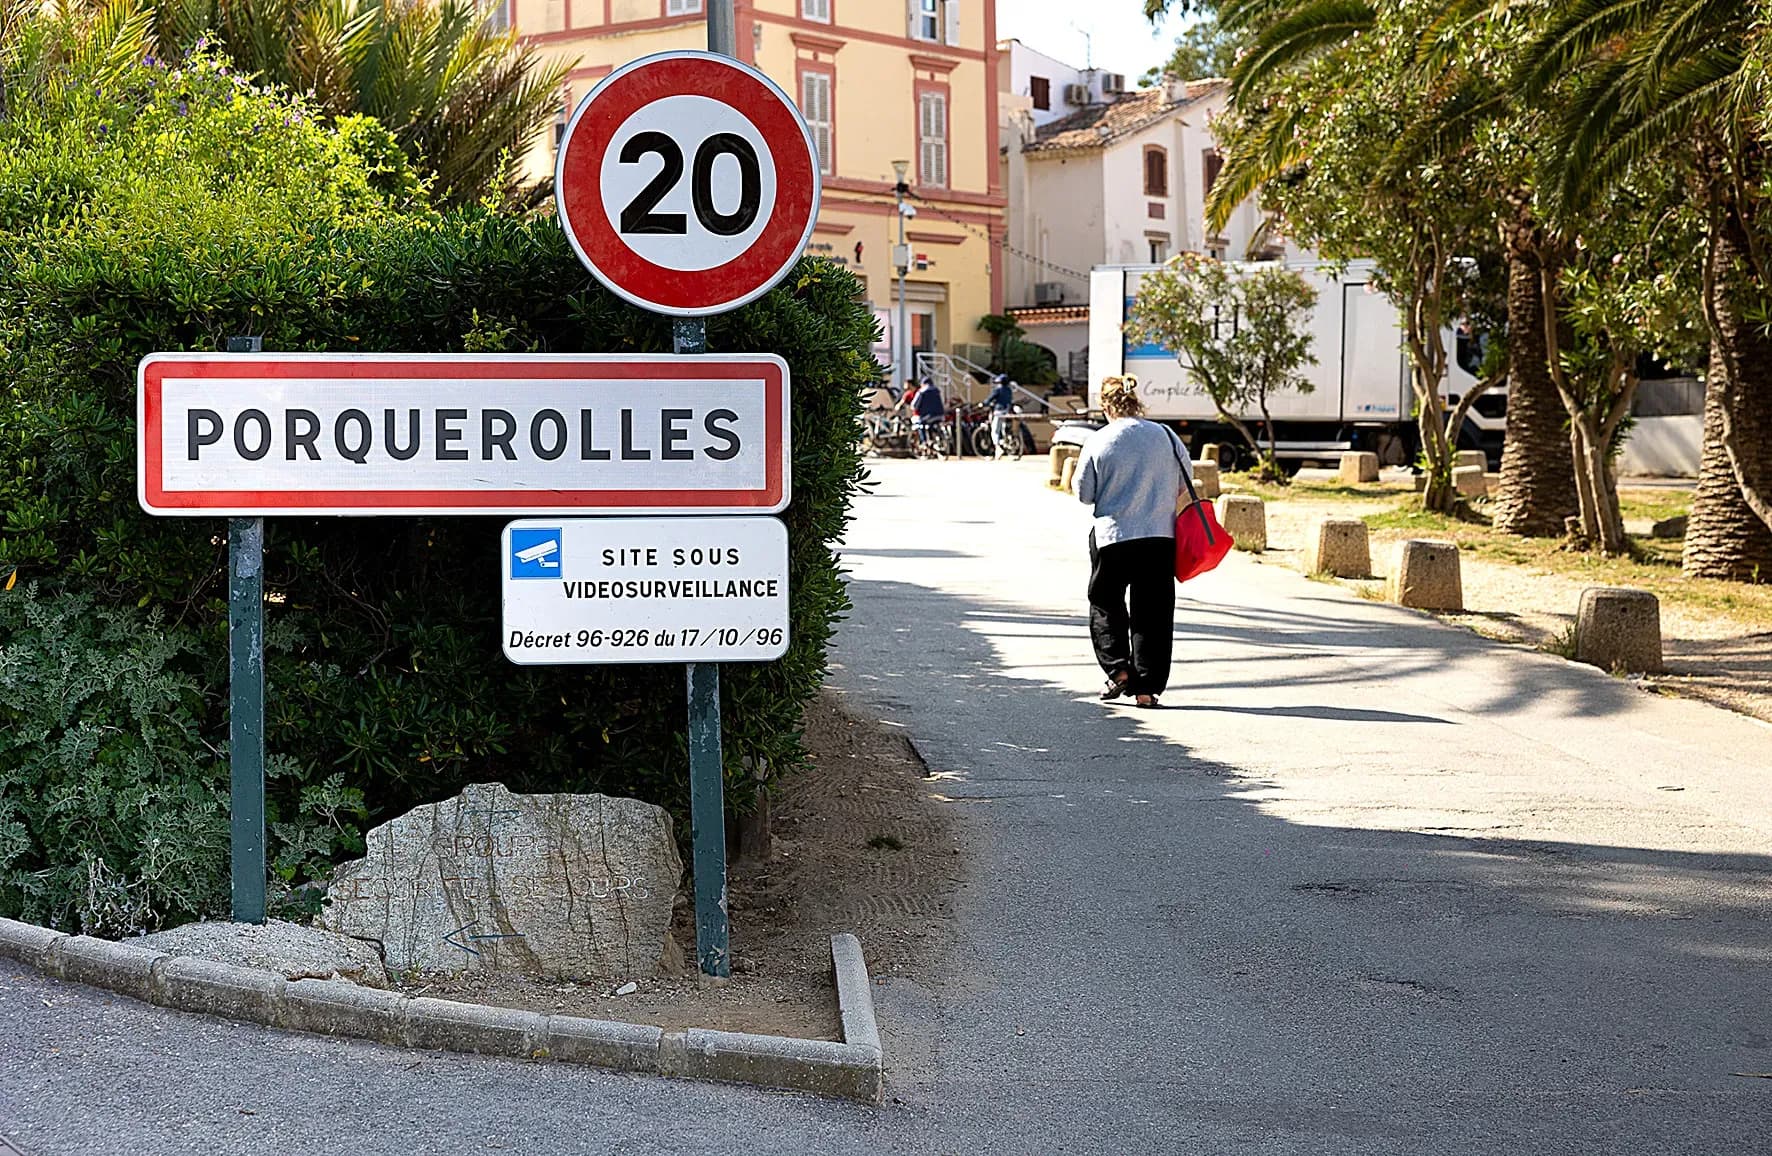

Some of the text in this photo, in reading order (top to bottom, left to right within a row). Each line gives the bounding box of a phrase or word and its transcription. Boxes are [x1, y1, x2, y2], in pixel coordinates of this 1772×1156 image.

[619, 131, 761, 236] 20
[187, 408, 742, 465] PORQUEROLLES
[602, 548, 740, 566] SITE SOUS
[563, 579, 778, 599] VIDEOSURVEILLANCE
[510, 630, 572, 648] Décret
[576, 629, 650, 648] 96-926
[655, 629, 676, 647] du
[512, 875, 649, 899] SECOURS
